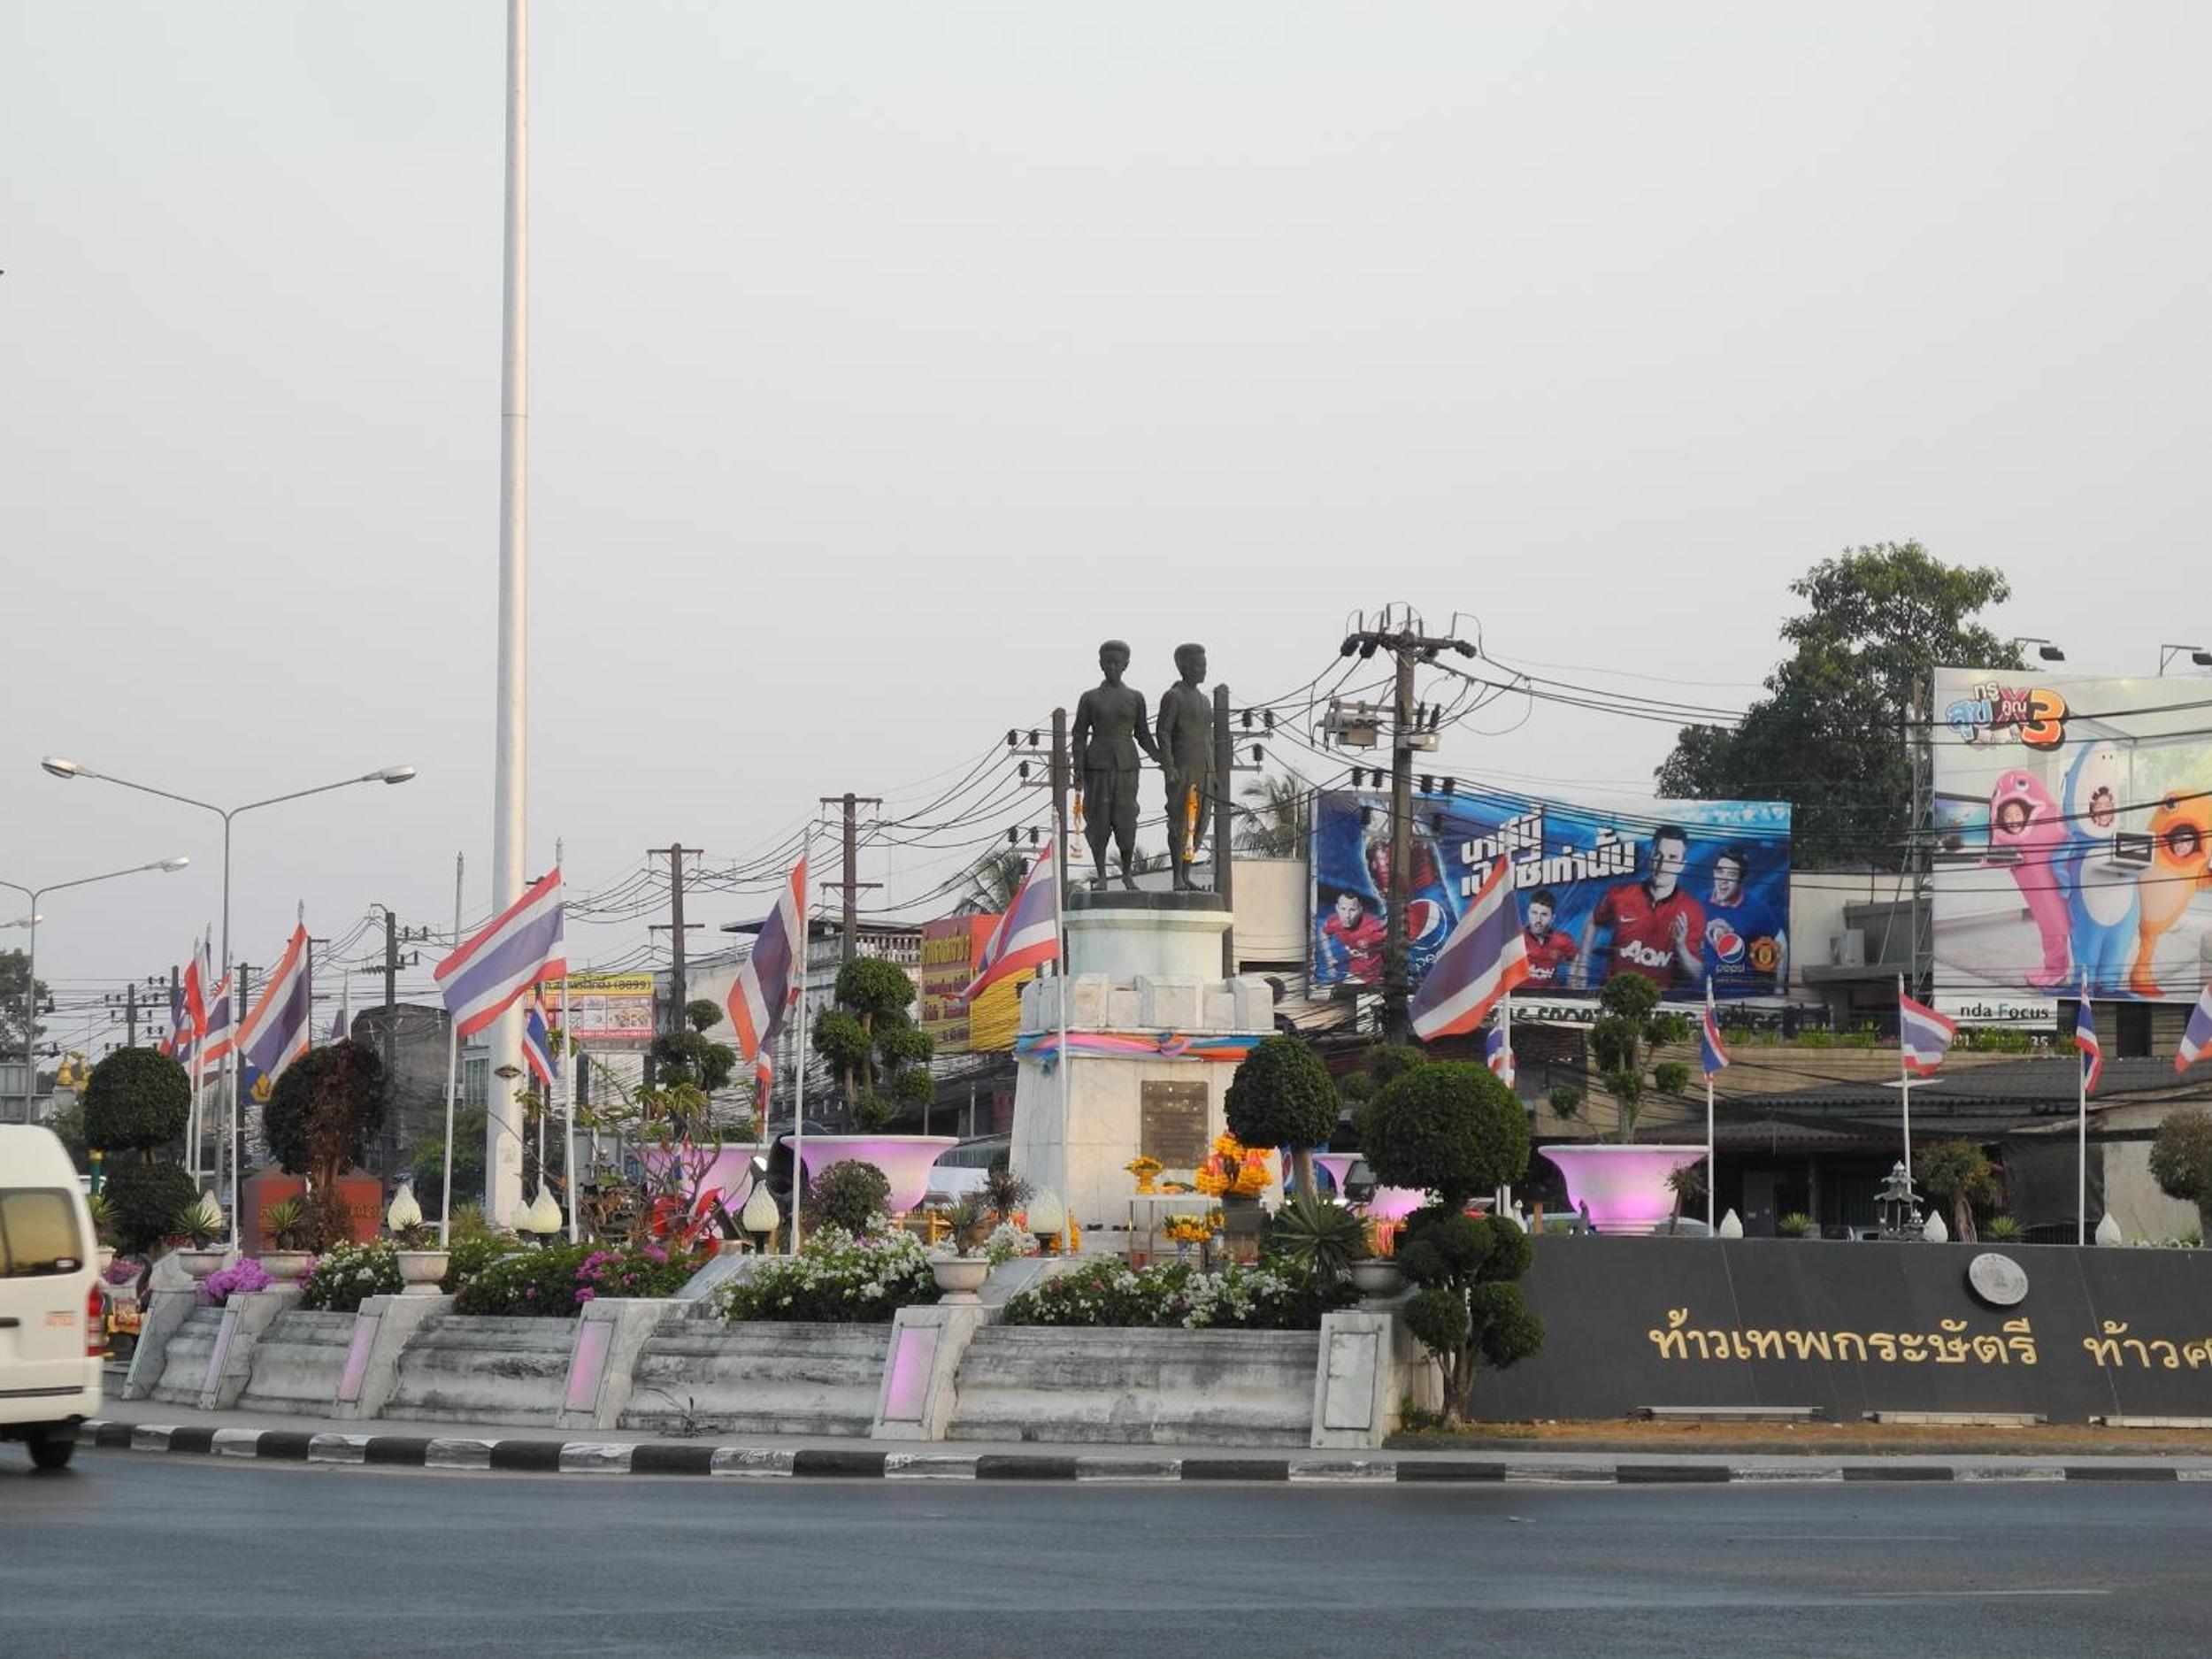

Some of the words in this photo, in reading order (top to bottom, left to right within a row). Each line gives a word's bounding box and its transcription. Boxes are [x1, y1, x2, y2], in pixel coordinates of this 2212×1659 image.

[2021, 689, 2067, 743] 3
[1998, 1002, 2050, 1020] Focus
[1648, 1307, 2039, 1365] ท้าวเทพกระษัตรี
